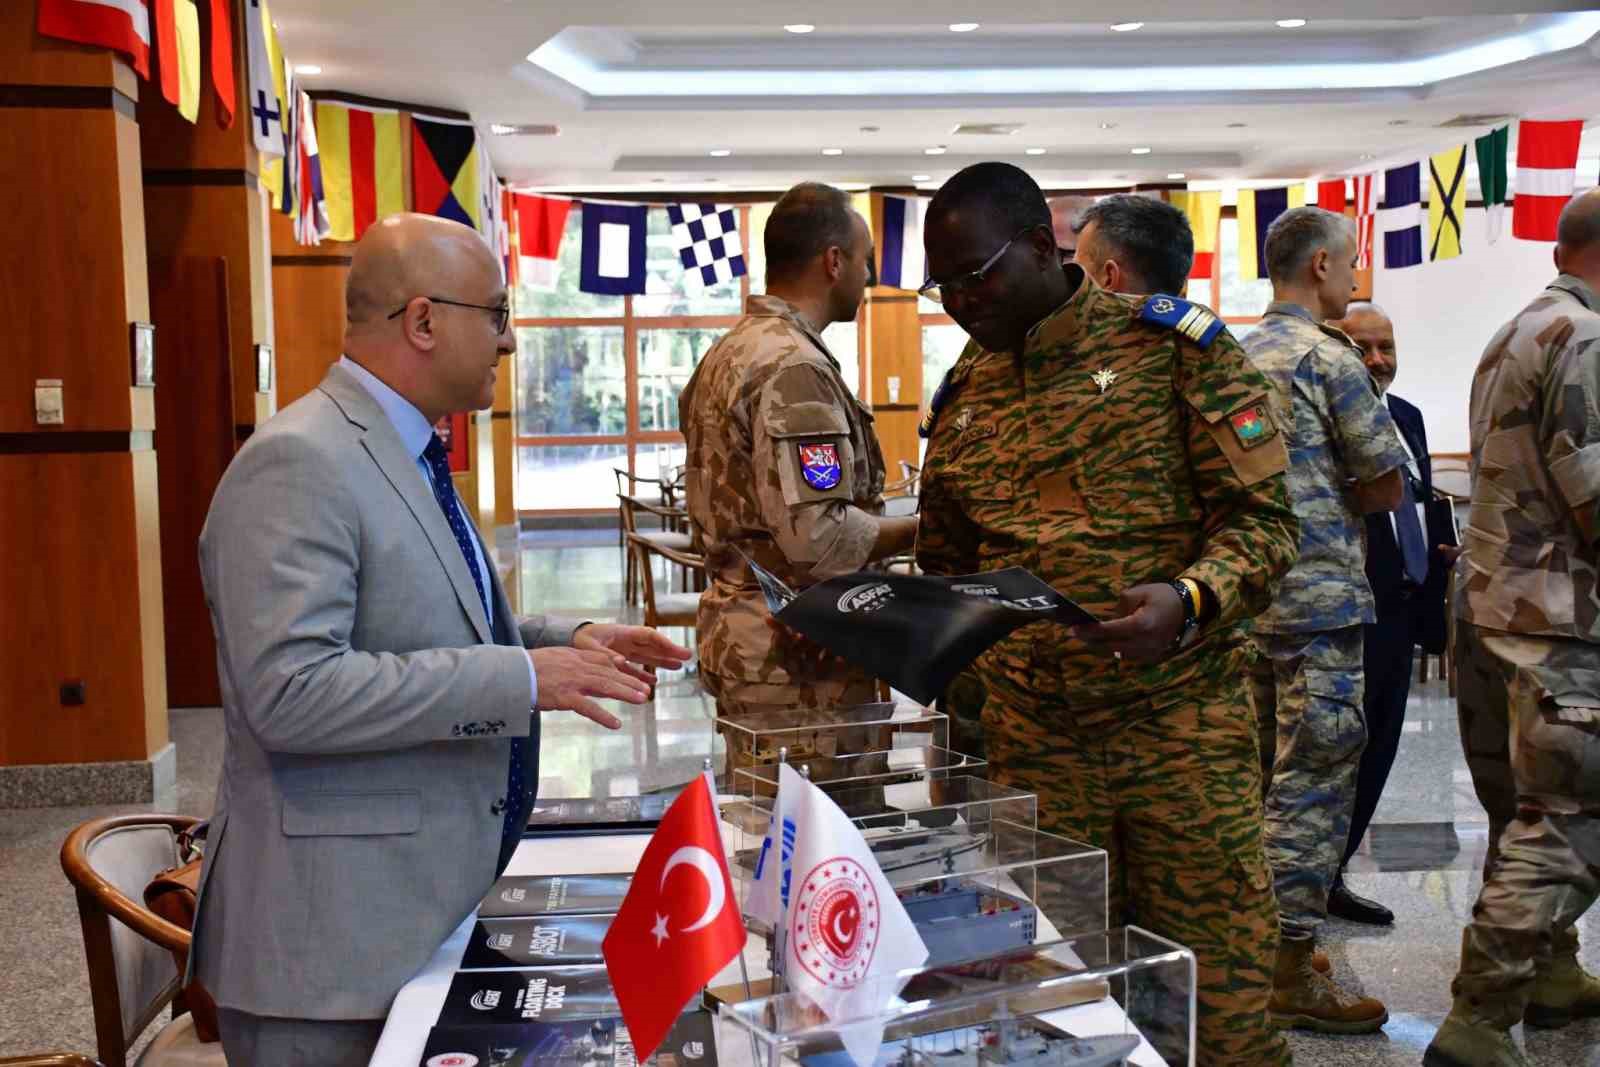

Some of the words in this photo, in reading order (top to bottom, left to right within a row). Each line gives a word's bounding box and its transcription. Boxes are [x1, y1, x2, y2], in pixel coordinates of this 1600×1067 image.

[851, 583, 893, 609] ASFAT
[528, 926, 561, 956] ASBOT
[521, 978, 547, 1018] FLOATING
[544, 985, 566, 1009] DOCK
